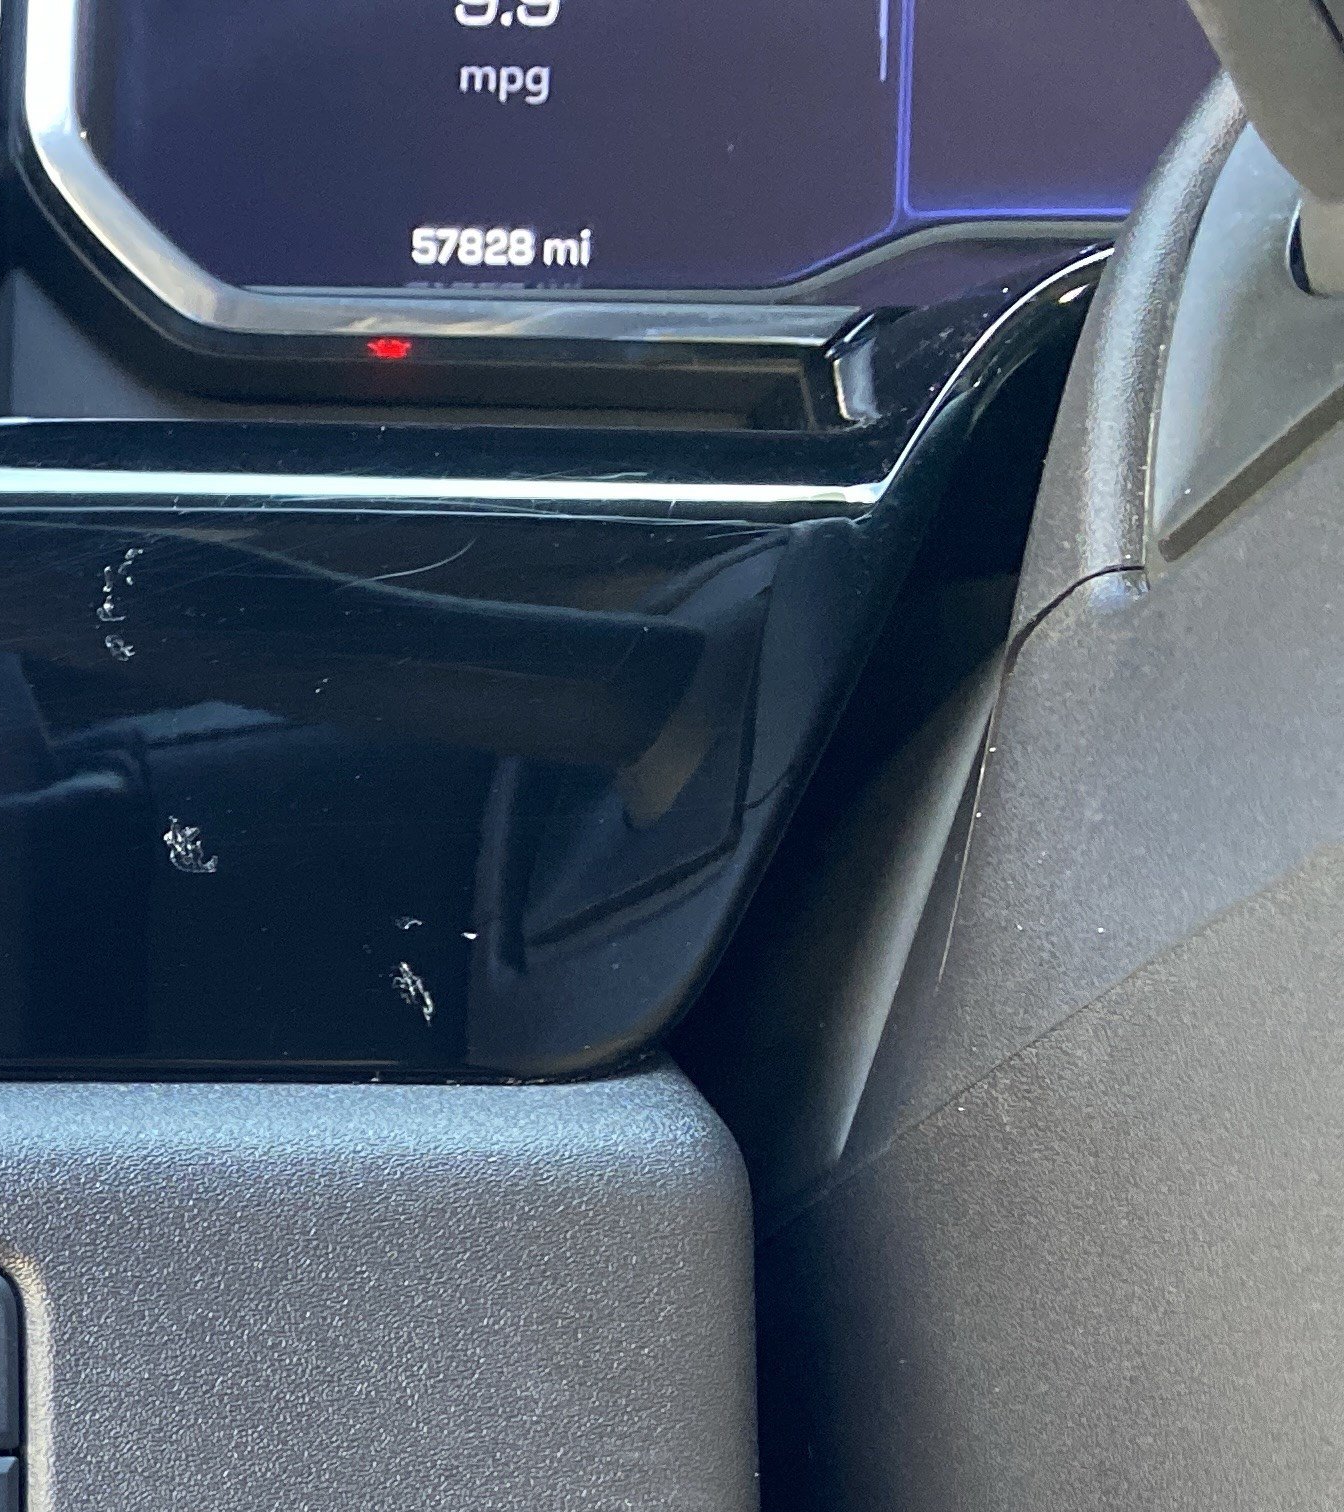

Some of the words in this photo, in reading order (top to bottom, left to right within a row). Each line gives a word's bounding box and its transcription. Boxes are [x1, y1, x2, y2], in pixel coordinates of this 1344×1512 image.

[459, 65, 551, 105] mpg
[411, 227, 536, 266] 57828
[543, 228, 592, 267] mi
